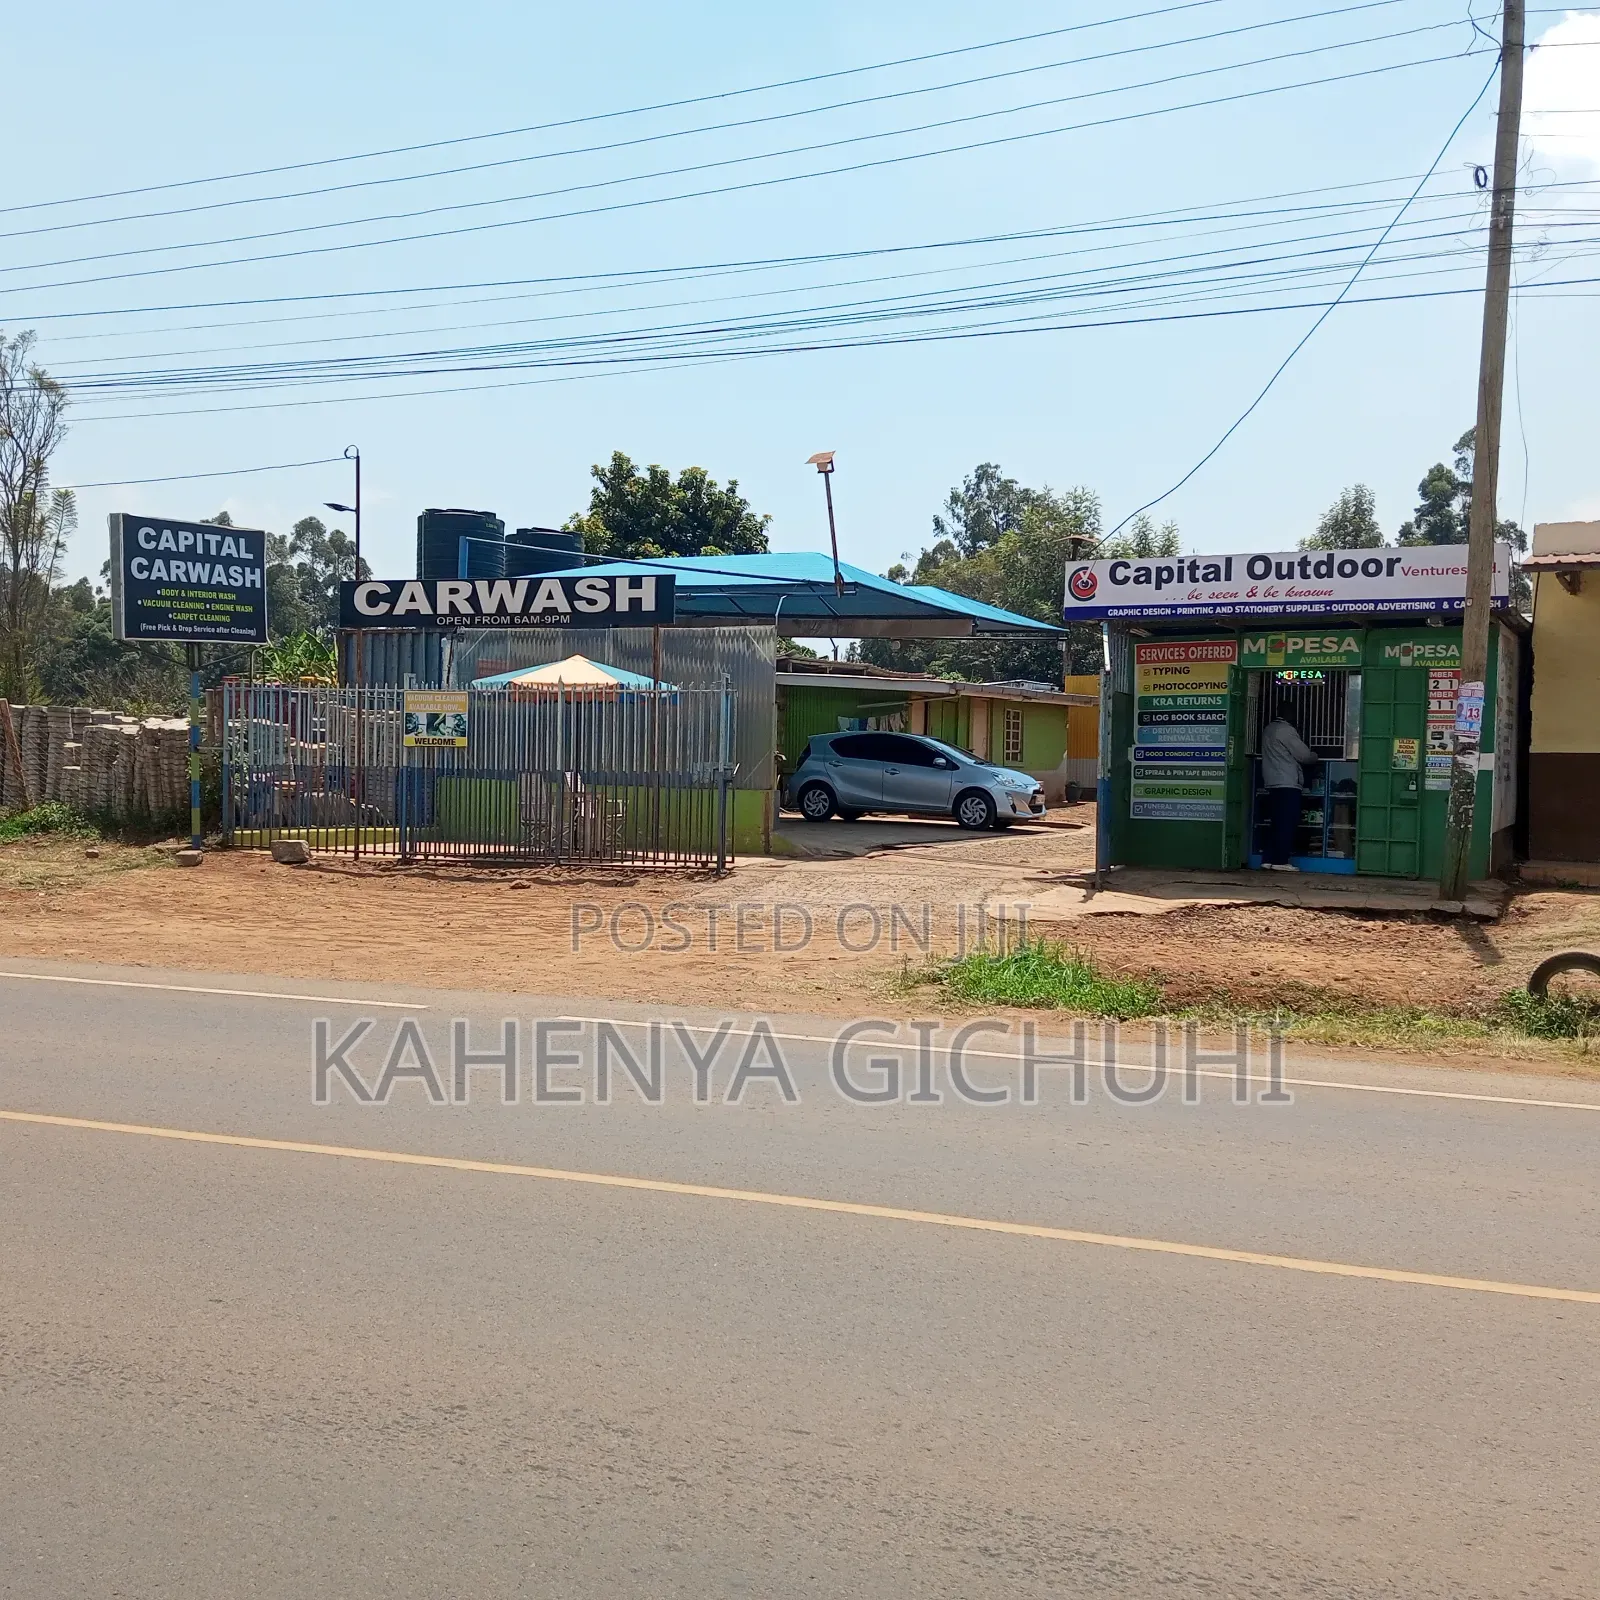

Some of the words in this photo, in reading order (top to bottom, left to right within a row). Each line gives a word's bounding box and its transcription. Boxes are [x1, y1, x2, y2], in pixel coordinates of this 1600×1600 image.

[137, 526, 254, 560] CAPITAL
[130, 556, 261, 588] CARWASH
[1108, 556, 1233, 590] Capital
[1246, 552, 1402, 580] Outdoor
[1402, 564, 1468, 576] Ventures
[161, 589, 179, 597] BODY
[187, 590, 217, 599] INTERIOR
[218, 592, 236, 600] WASH
[353, 577, 657, 616] CARWASH
[1208, 591, 1239, 599] seen
[1246, 586, 1257, 598] &
[1264, 586, 1279, 598] be
[1284, 585, 1335, 598] known
[143, 599, 171, 608] VACUUM
[172, 600, 205, 610] CLEANING
[211, 604, 235, 612] ENGINE
[236, 604, 253, 613] WASH
[1108, 608, 1141, 616] GRAPHIC
[1143, 607, 1171, 616] DESIGN
[1177, 607, 1213, 615] PRINTING
[1215, 606, 1233, 614] AND
[1235, 605, 1283, 614] STATIONERY
[1285, 603, 1325, 613] SUPPLIES
[1331, 602, 1375, 612] OUTDOOR
[1376, 601, 1436, 611] ADVERTISING
[1442, 601, 1450, 609] &
[173, 612, 198, 621] CARPET
[199, 613, 231, 622] CLEANING
[436, 615, 471, 626] OPEN
[474, 615, 510, 625] FROM
[514, 614, 571, 625] 6AM-9PM
[140, 623, 156, 632] (Free
[158, 623, 171, 631] Pick
[178, 625, 192, 634] Drop
[193, 625, 215, 633] Service
[216, 625, 230, 634] after
[230, 626, 257, 636] Cleaning)
[1140, 647, 1186, 661] SERVICES
[1188, 646, 1233, 659] OFFERED
[1300, 656, 1347, 664] AVAILABLE
[1413, 659, 1461, 667] AVAILABLE
[1152, 666, 1190, 675] TYPING
[1152, 682, 1228, 691] PHOTOCOPYING
[1432, 680, 1440, 689] 2
[1448, 680, 1453, 689] 1
[1152, 697, 1174, 706] KRA
[1176, 696, 1222, 705] RETURNS
[1468, 708, 1480, 718] 13
[1145, 787, 1180, 795] GRAPHIC
[1182, 788, 1212, 796] DESIGN
